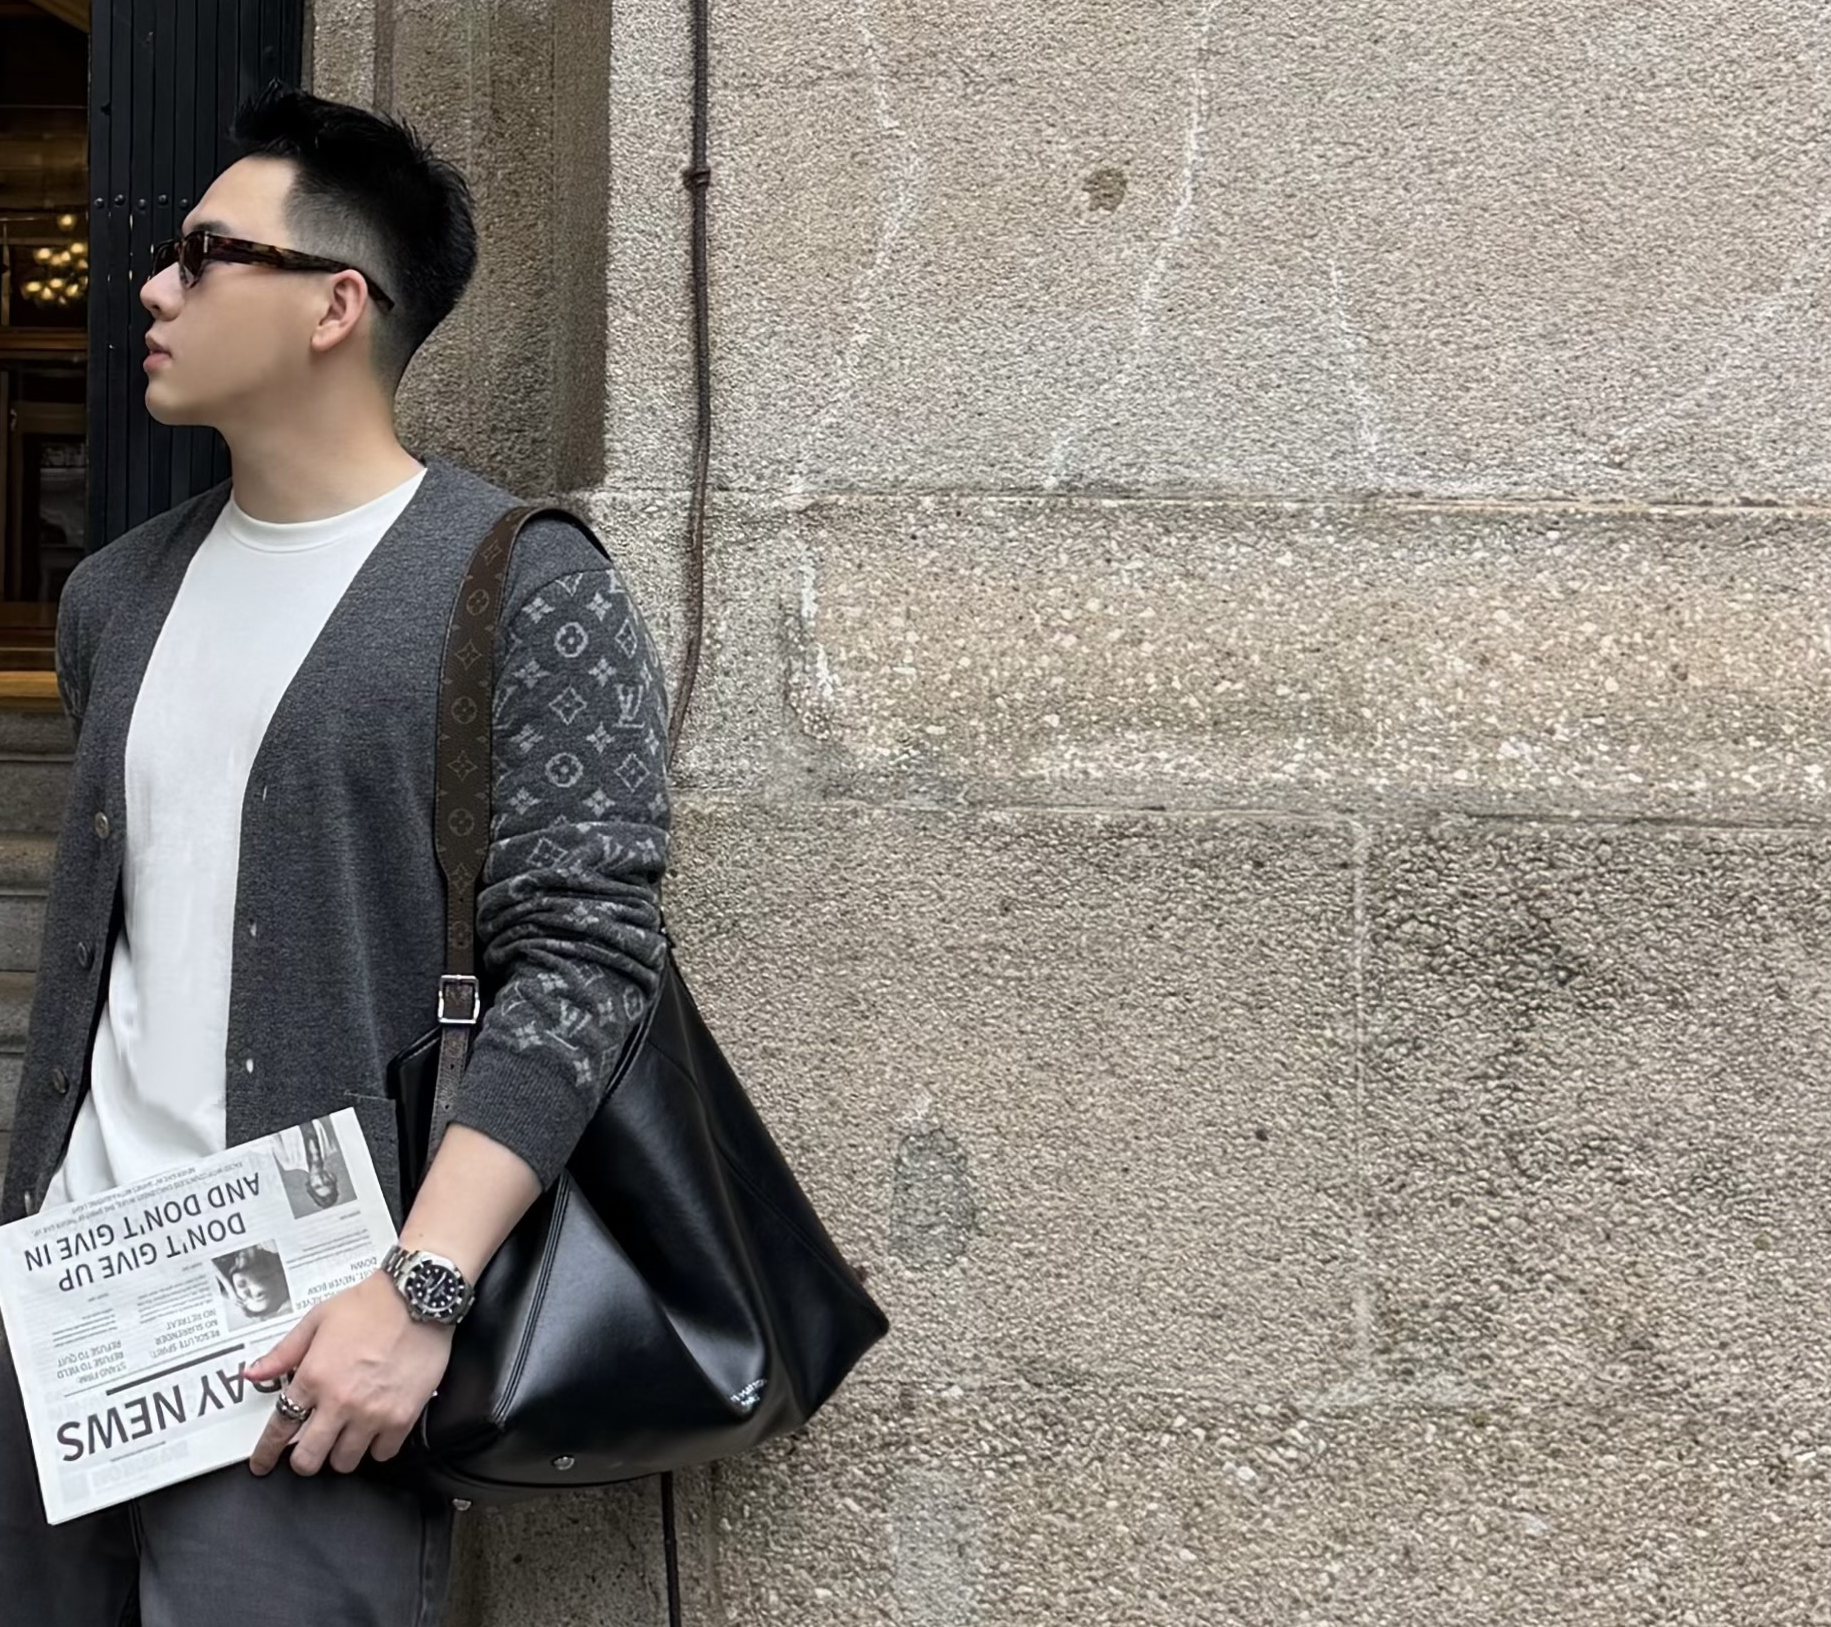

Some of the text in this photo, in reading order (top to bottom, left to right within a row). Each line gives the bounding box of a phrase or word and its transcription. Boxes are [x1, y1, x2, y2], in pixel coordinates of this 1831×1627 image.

[208, 1173, 258, 1208] AND
[124, 1194, 201, 1239] DON'T
[57, 1224, 114, 1260] GIVE
[167, 1213, 245, 1258] DON'T
[25, 1244, 51, 1271] IN
[99, 1243, 157, 1278] GIVE
[59, 1264, 93, 1291] UP
[58, 1385, 185, 1461] NEWS
